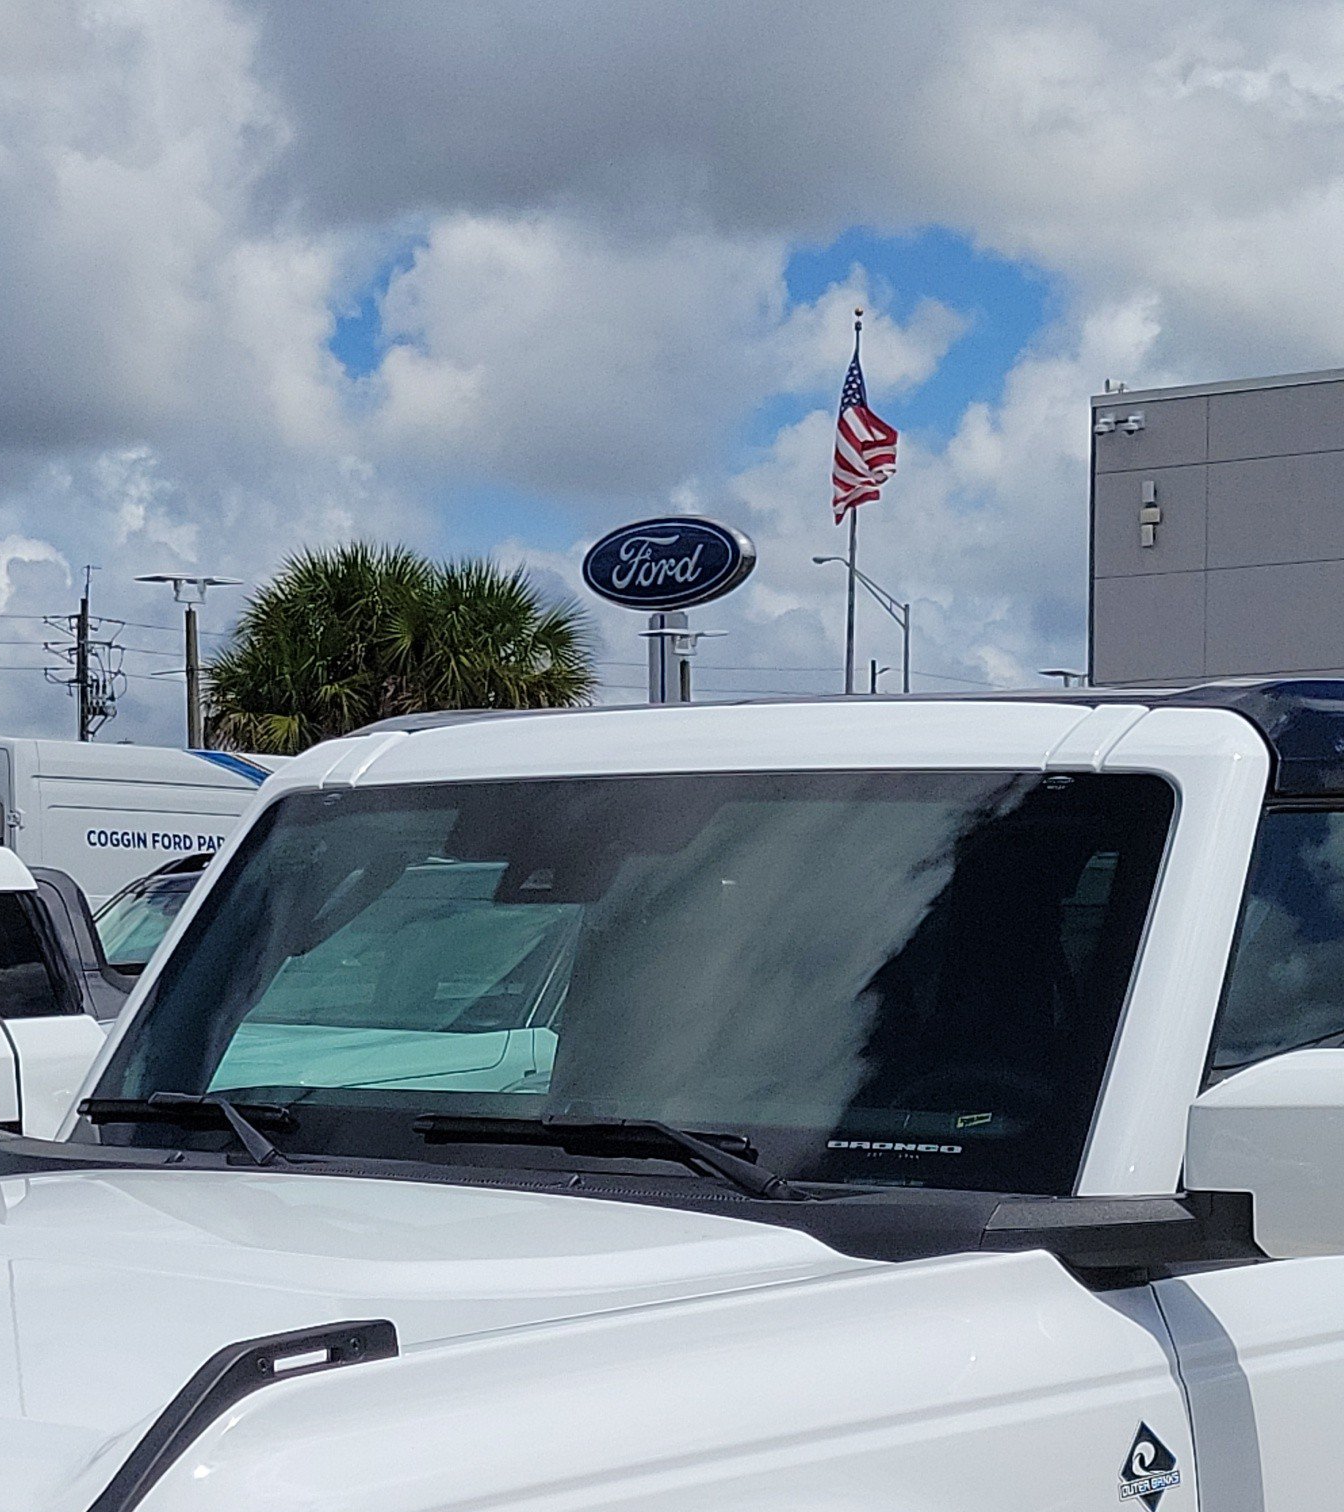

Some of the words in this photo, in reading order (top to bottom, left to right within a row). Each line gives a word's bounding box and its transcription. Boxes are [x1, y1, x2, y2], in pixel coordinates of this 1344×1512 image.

[611, 534, 705, 589] Ford
[87, 830, 147, 849] COGGIN
[152, 832, 193, 850] FORD
[1122, 1480, 1150, 1497] OUTER
